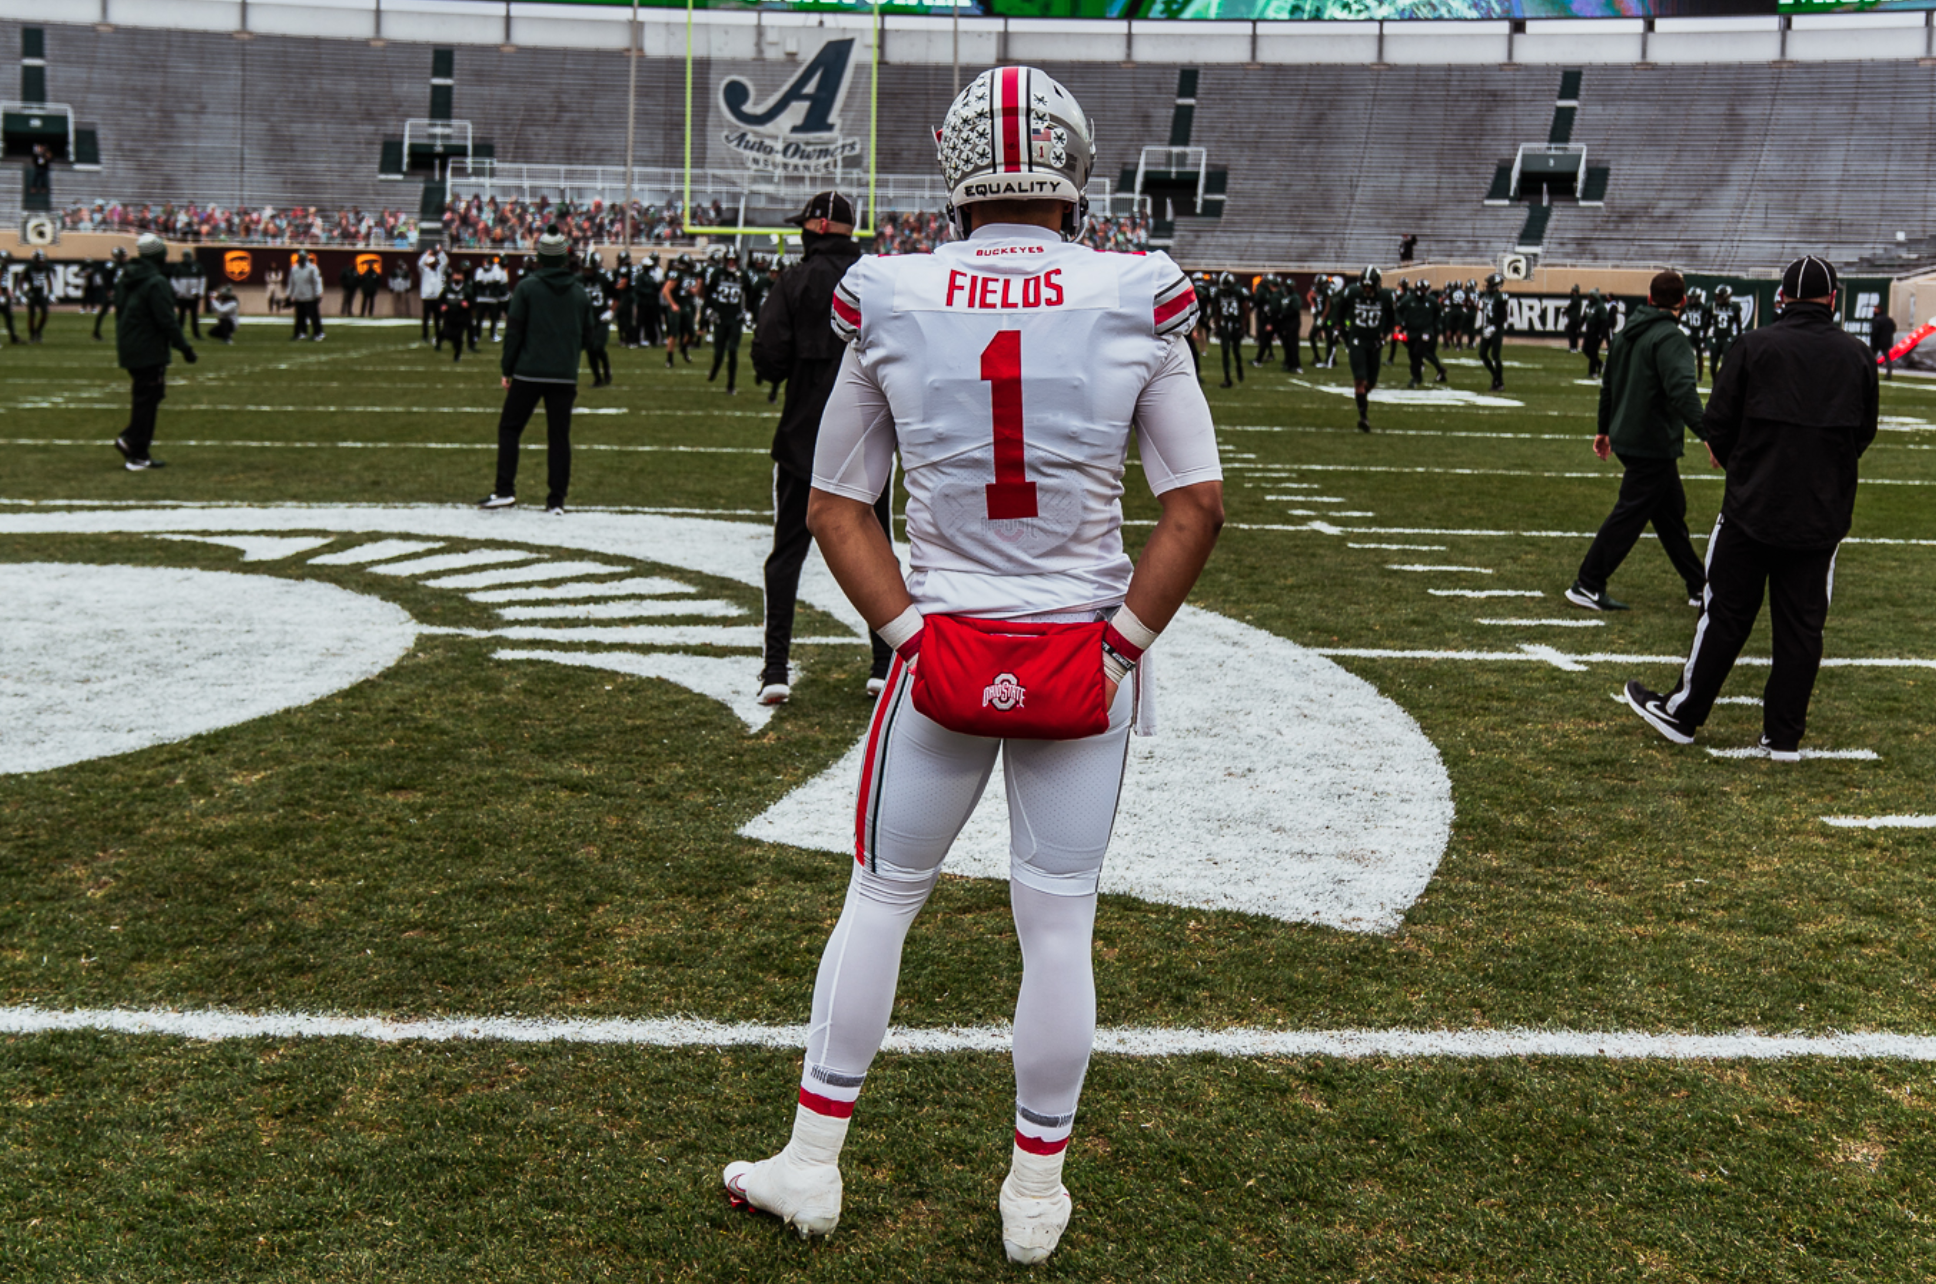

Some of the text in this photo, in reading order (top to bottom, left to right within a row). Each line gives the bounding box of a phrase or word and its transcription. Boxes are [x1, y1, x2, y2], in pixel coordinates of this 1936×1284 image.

[724, 131, 858, 161] Auto-Owners
[964, 180, 1061, 198] EQUALITY
[976, 246, 1044, 257] BUCKEYES
[945, 268, 1065, 309] FIELDS
[980, 330, 1038, 520] 1
